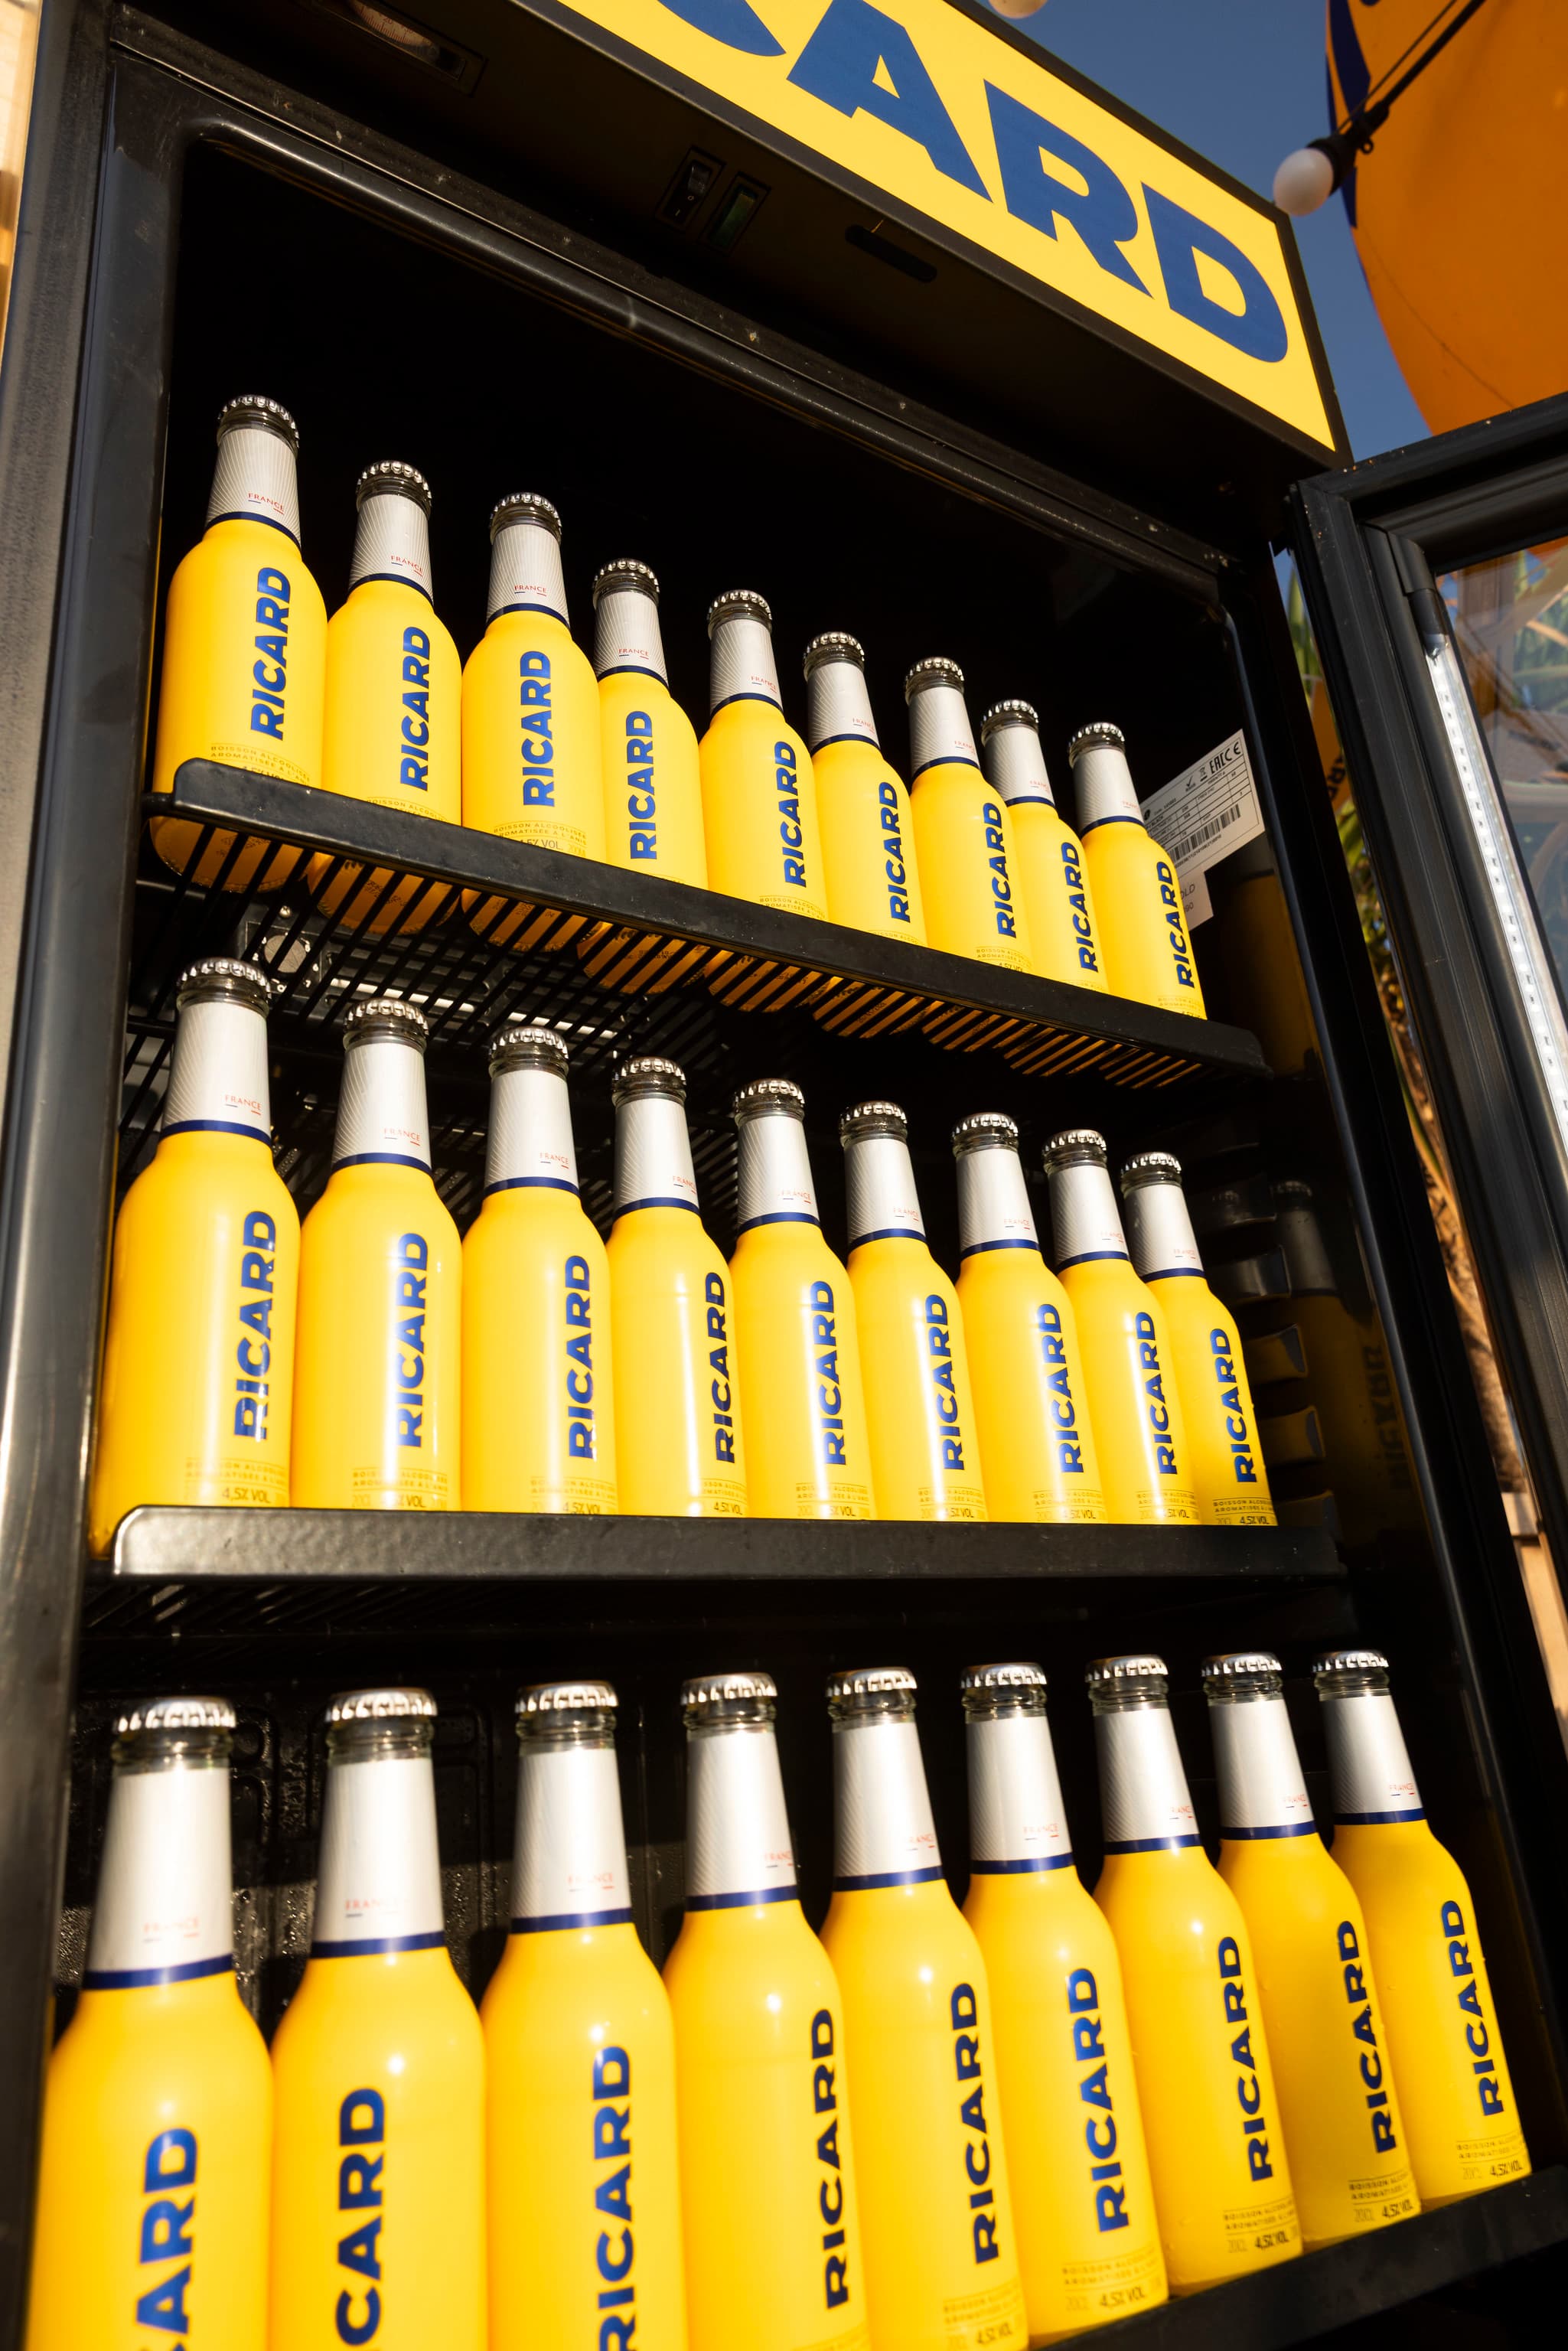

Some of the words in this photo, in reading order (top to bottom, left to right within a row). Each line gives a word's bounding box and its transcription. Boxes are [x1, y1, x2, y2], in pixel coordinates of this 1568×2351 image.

[248, 492, 285, 512] FRANCE
[391, 555, 423, 572] FRANCE
[251, 567, 290, 740] RICARD
[514, 585, 547, 594] FRANCE
[618, 648, 650, 657] FRANCE
[400, 627, 430, 791] RICARD
[520, 651, 555, 807] RICARD
[625, 710, 657, 860] RICARD
[774, 741, 806, 888] RICARD
[879, 781, 910, 923] RICARD
[983, 802, 1015, 937] RICARD
[1061, 842, 1098, 972] RICARD
[1156, 862, 1194, 988] RICARD
[225, 1094, 262, 1110] FRANCE
[540, 1153, 569, 1164] FRANCE
[234, 1211, 275, 1442] RICARD
[396, 1232, 429, 1448] RICARD
[565, 1255, 597, 1459] RICARD
[705, 1272, 735, 1463] RICARD
[810, 1280, 846, 1465] RICARD
[925, 1294, 964, 1470] RICARD
[1036, 1303, 1084, 1473] RICARD
[1136, 1312, 1178, 1475] RICARD
[1210, 1329, 1257, 1483] RICARD
[1218, 1936, 1273, 2182] RICARD
[1338, 1921, 1396, 2154] RICARD
[1442, 1899, 1504, 2117] RICARD
[811, 2008, 849, 2310] RICARD
[950, 1983, 999, 2265] RICARD
[1068, 1968, 1130, 2233] RICARD
[136, 2128, 197, 2351] ARD
[337, 2089, 386, 2351] CARD
[592, 2046, 635, 2351] RICARD
